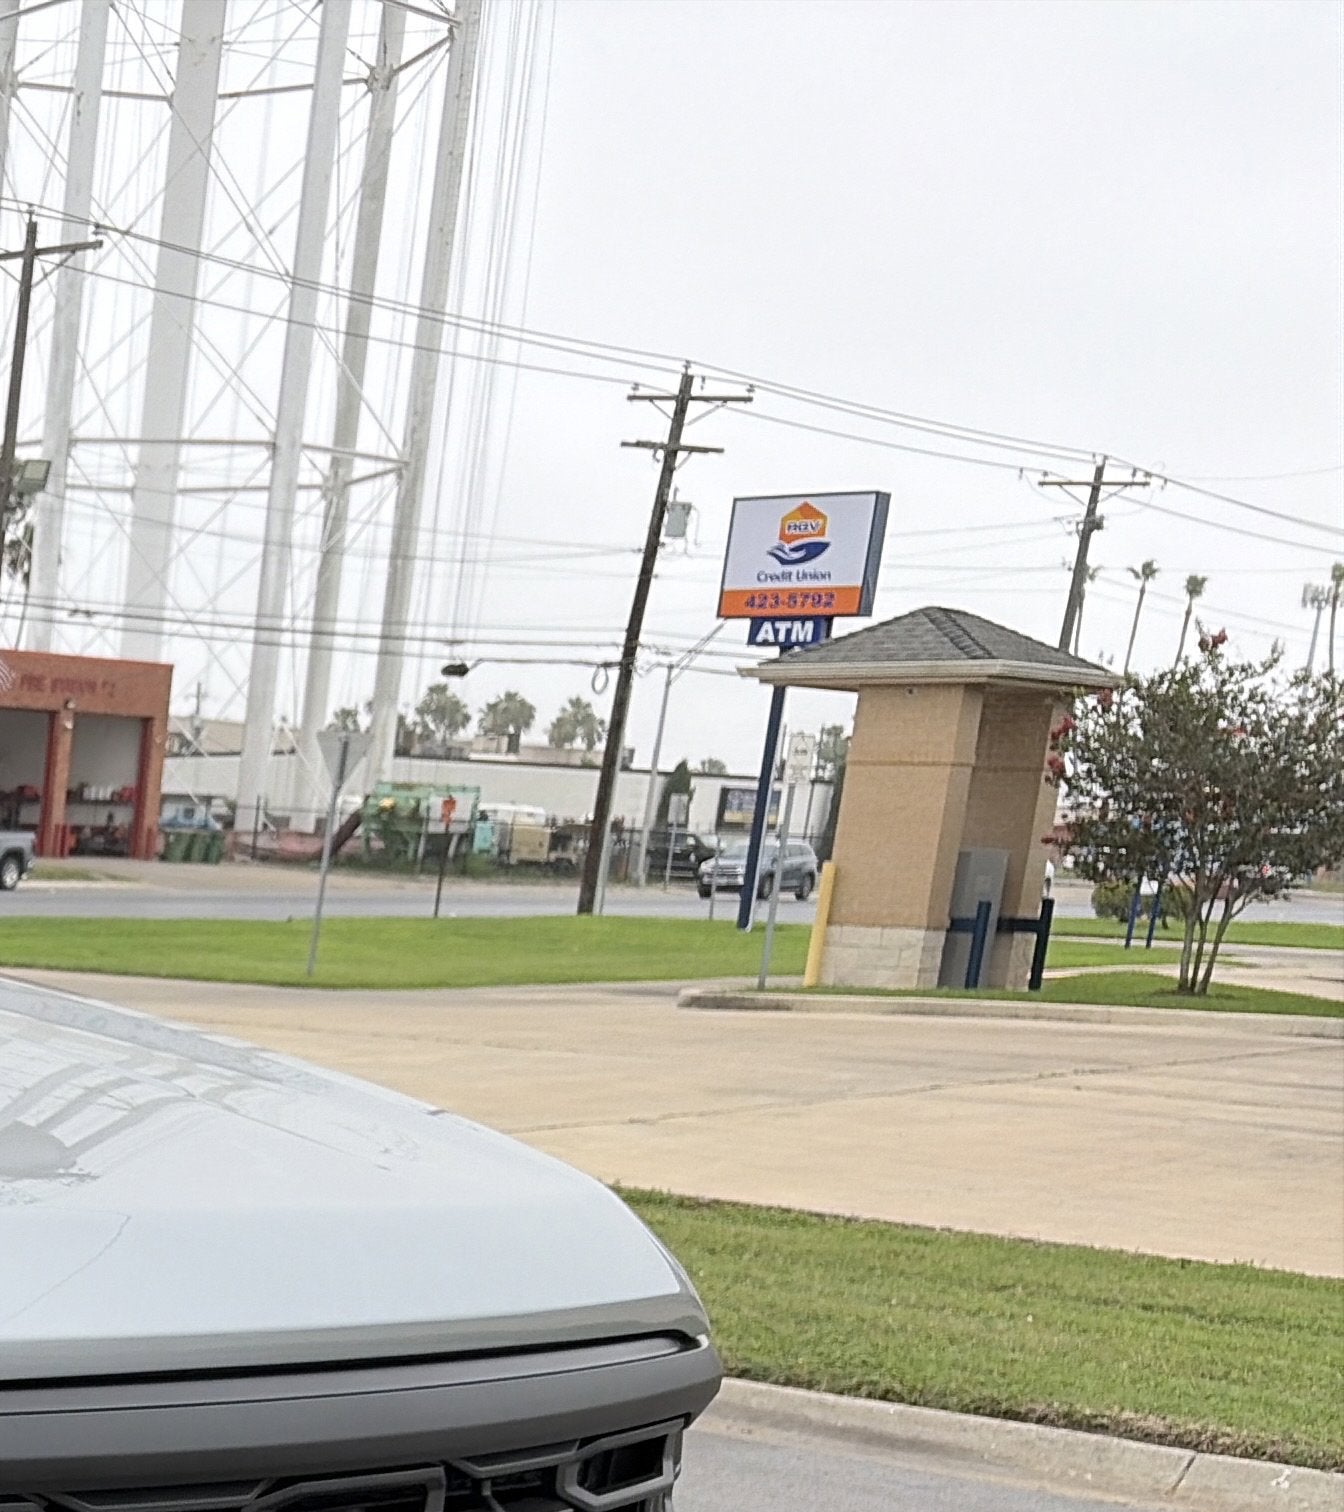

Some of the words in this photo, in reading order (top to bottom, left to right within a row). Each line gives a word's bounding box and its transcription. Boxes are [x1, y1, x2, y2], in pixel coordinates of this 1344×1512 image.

[756, 570, 793, 583] Credit
[796, 568, 832, 582] Union
[744, 592, 836, 609] 423-5792
[755, 620, 815, 643] ATM
